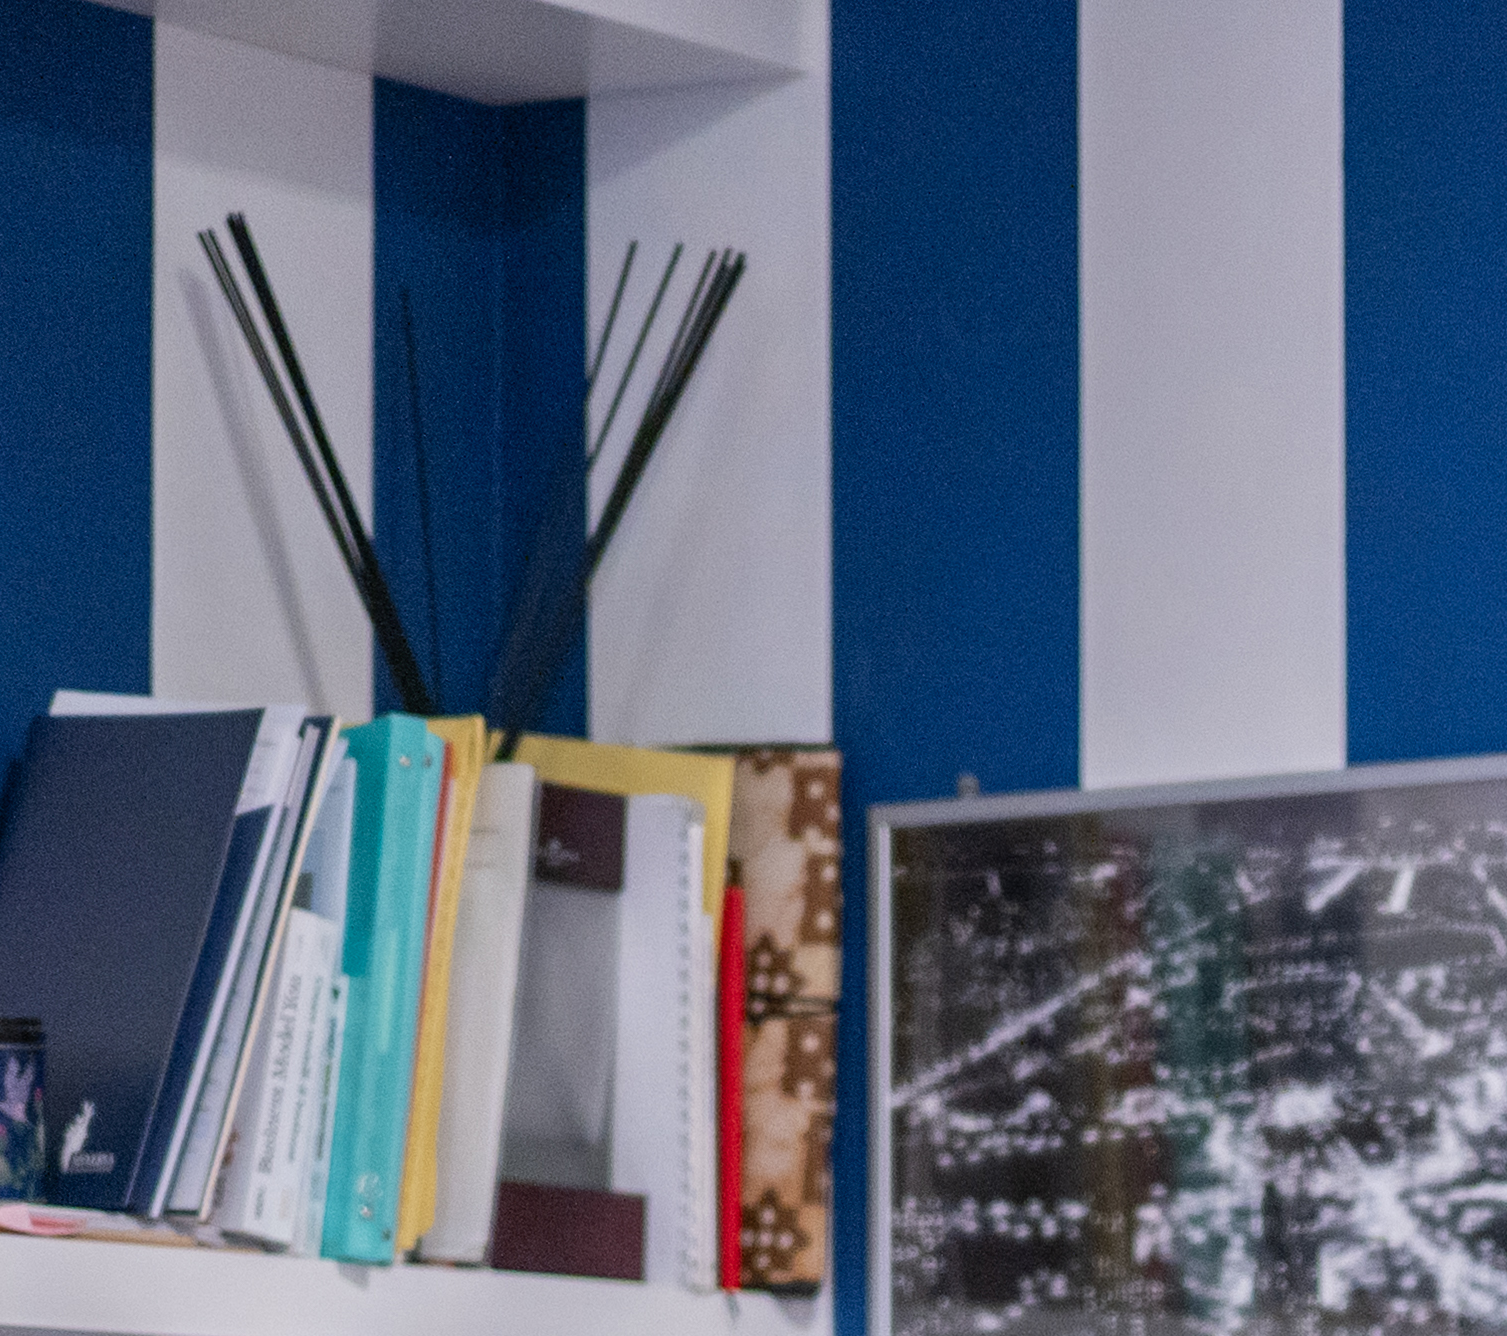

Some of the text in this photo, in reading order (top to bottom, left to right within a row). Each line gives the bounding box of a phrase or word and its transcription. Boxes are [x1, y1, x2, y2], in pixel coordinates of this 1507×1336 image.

[283, 974, 302, 1010] You
[273, 1015, 295, 1080] Model
[257, 1086, 284, 1174] Business
